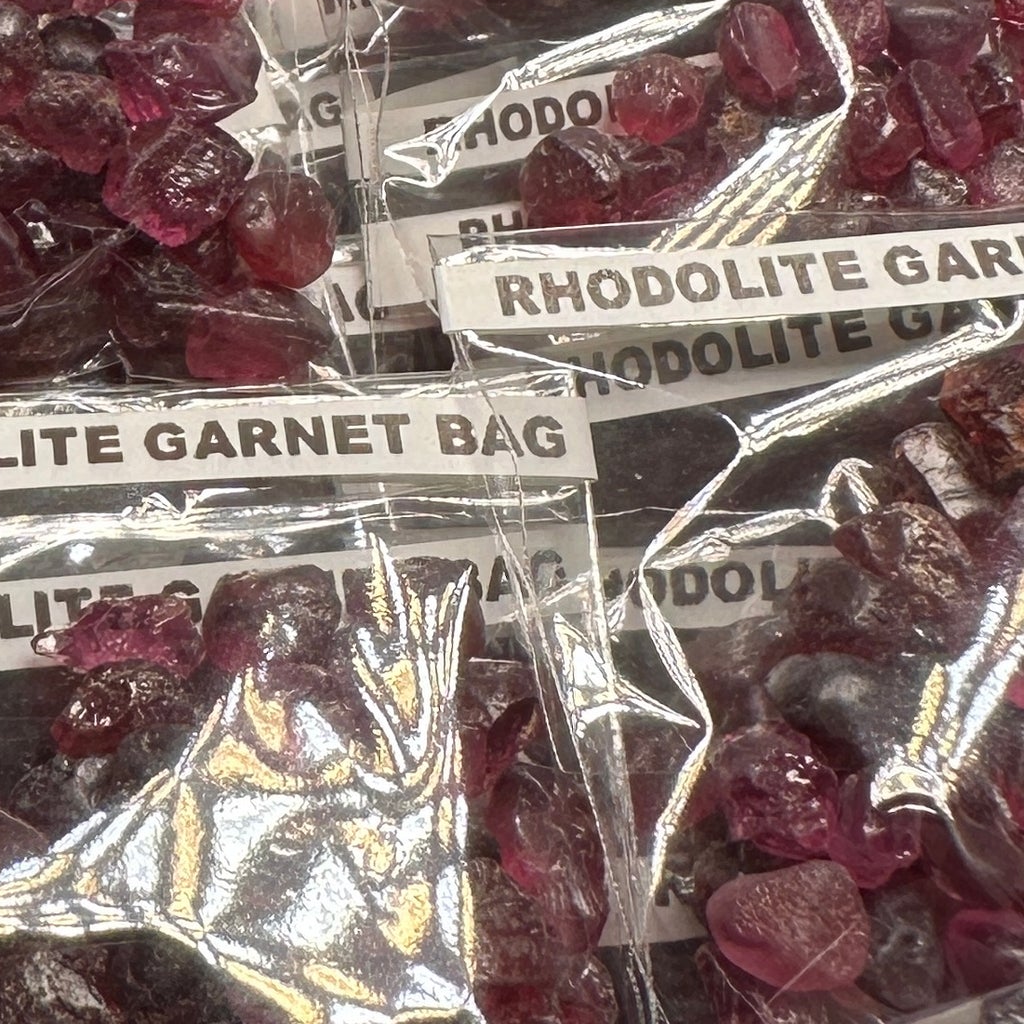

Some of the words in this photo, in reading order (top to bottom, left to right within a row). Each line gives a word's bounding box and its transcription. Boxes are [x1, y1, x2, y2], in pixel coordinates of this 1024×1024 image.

[495, 250, 869, 316] RHODOLITE
[883, 235, 1024, 286] GAR
[143, 413, 411, 462] GARNET
[435, 414, 567, 459] BAG
